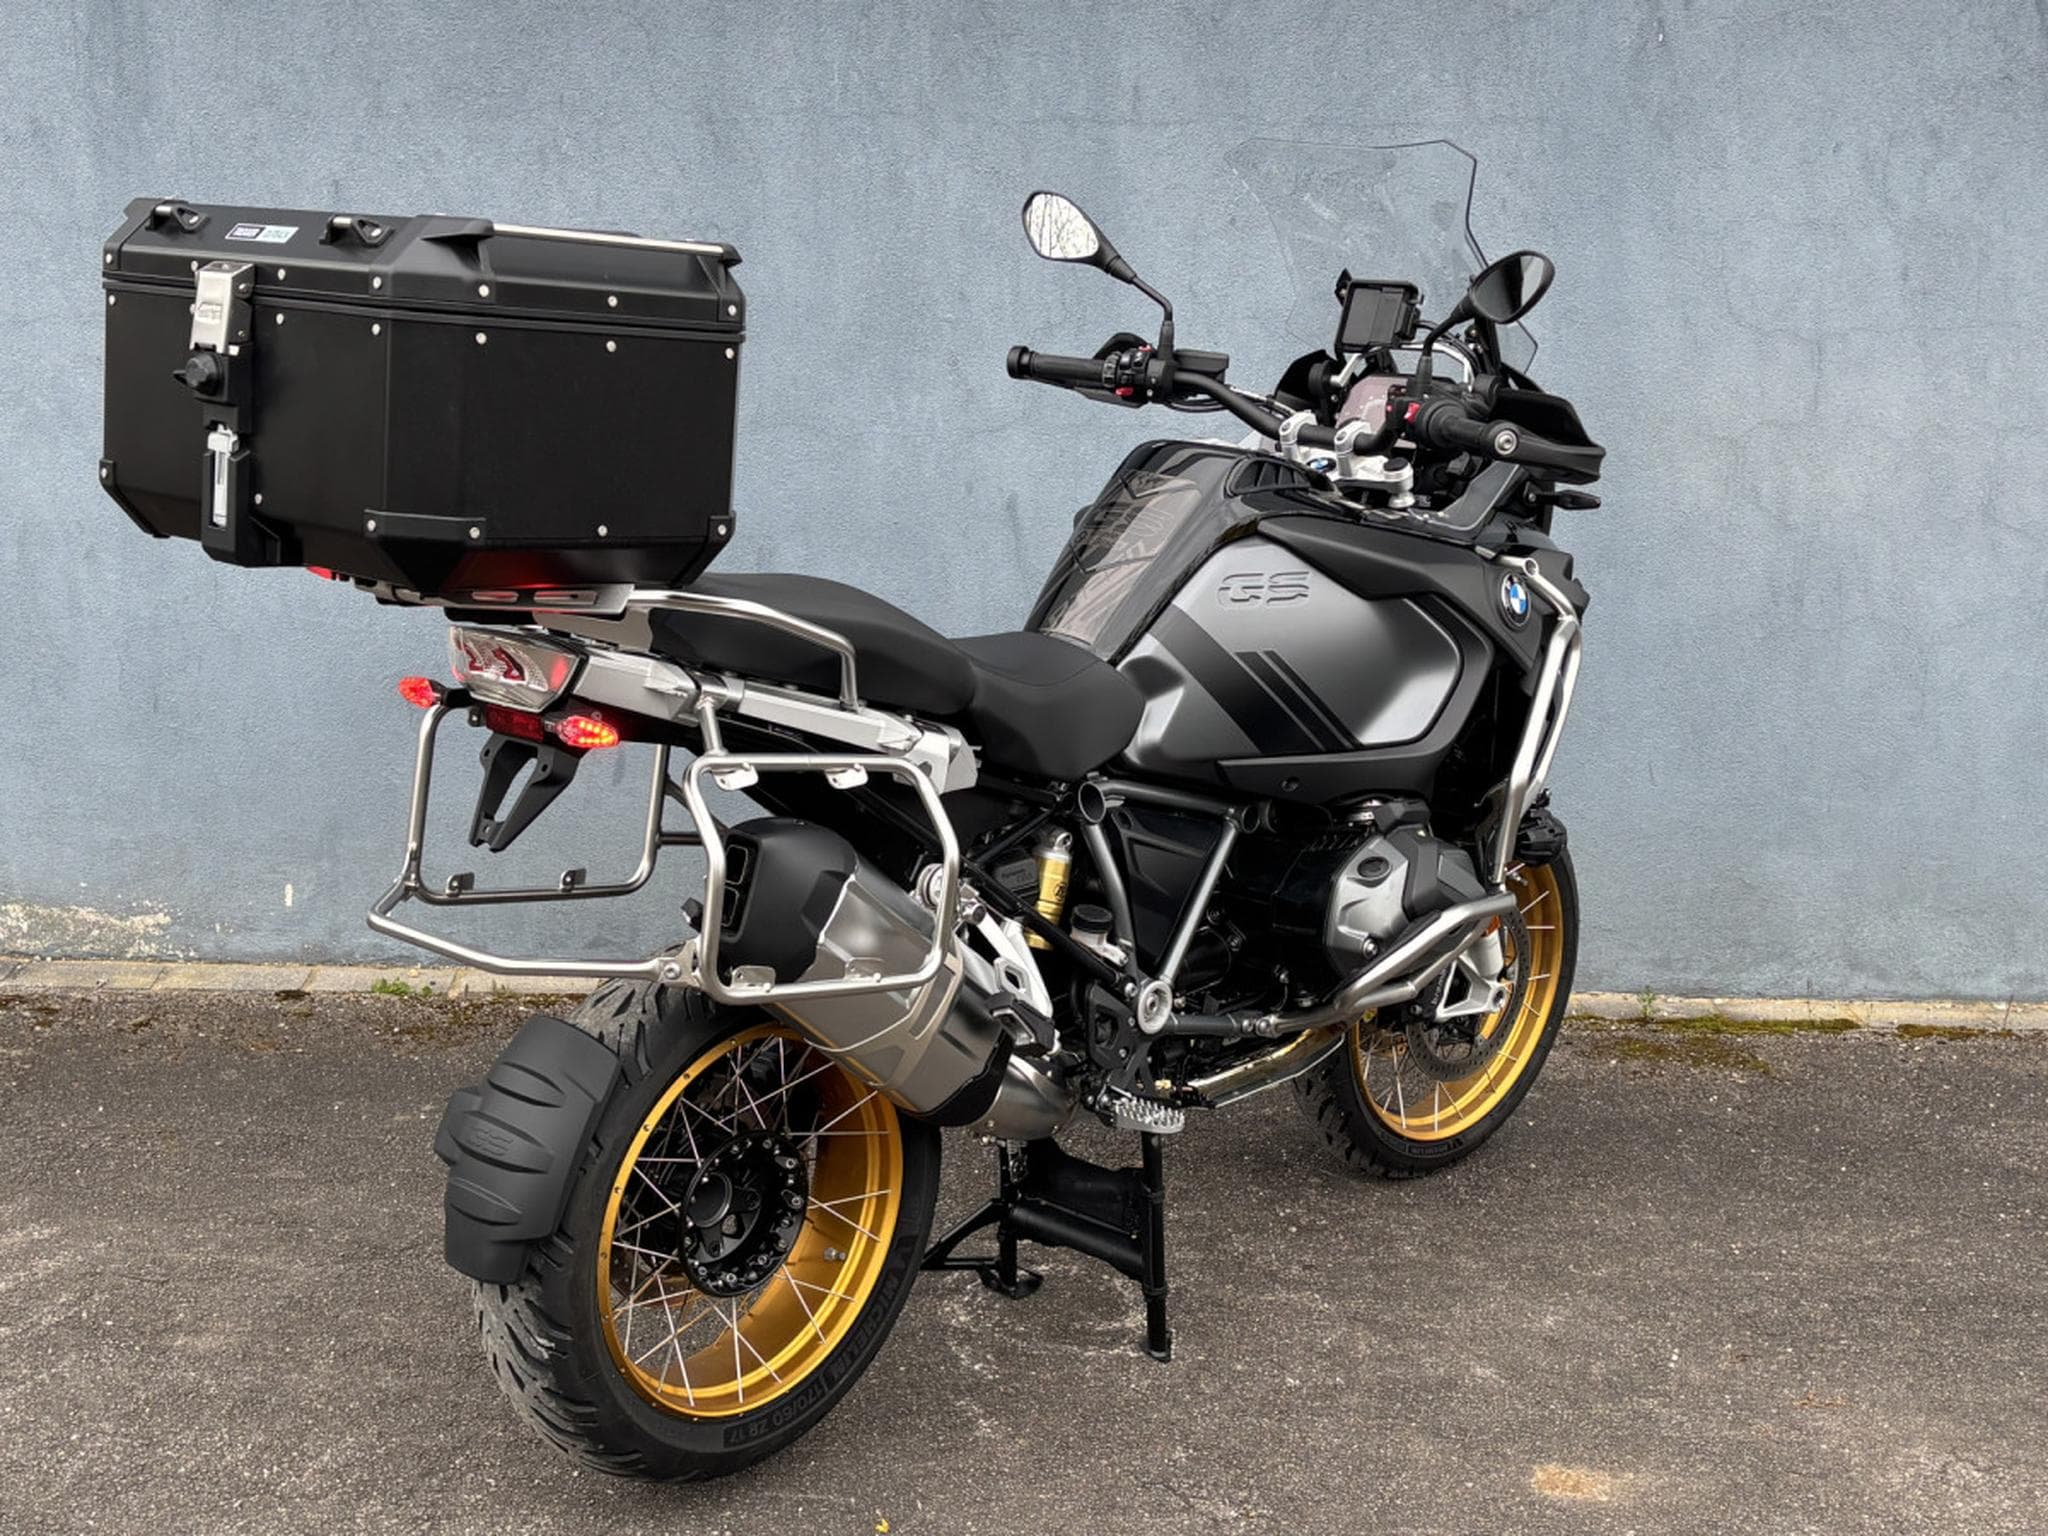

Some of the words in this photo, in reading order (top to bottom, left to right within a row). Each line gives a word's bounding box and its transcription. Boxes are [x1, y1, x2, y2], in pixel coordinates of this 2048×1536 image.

[1218, 571, 1310, 609] GS
[831, 1272, 901, 1376] MICHELIN
[774, 1382, 825, 1425] 170/60
